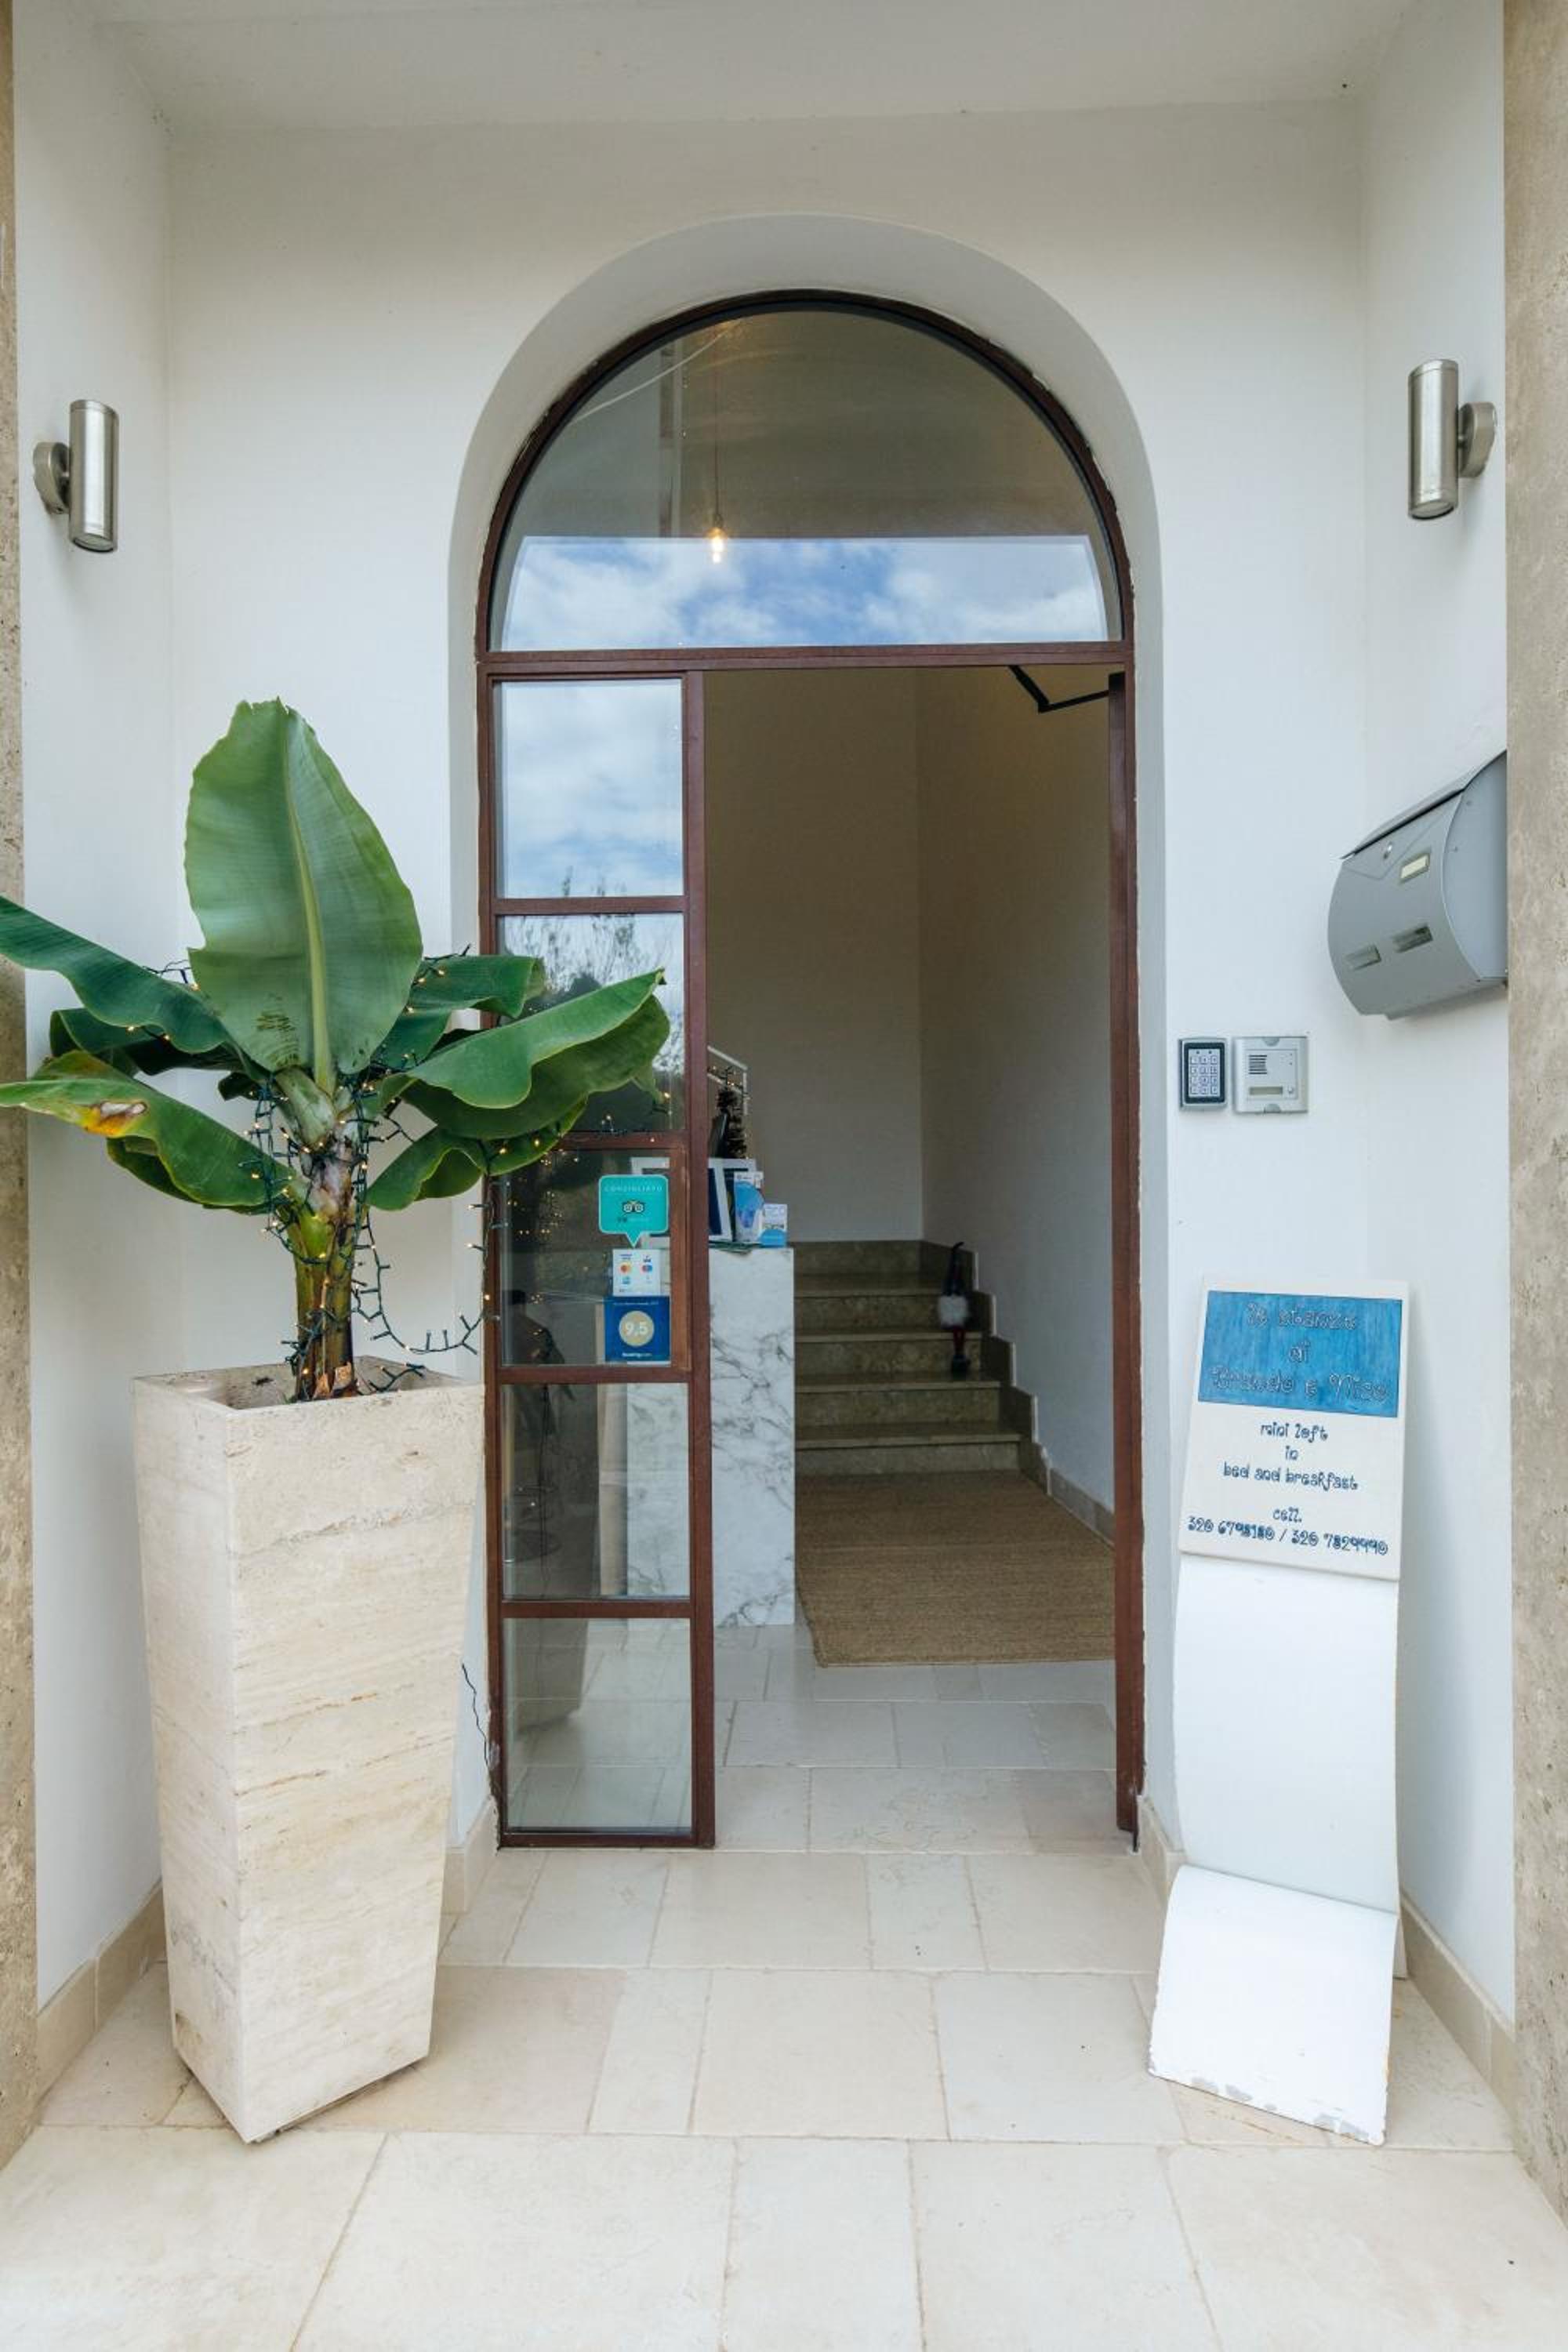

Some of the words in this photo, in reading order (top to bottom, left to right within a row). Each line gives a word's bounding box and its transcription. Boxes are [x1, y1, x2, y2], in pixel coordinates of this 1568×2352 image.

[1261, 1422, 1290, 1437] mini
[1294, 1423, 1328, 1443] loft
[1285, 1445, 1298, 1460] in
[1224, 1461, 1250, 1479] bed
[1254, 1468, 1281, 1483] and
[1286, 1468, 1359, 1490] breakfast
[1188, 1515, 1214, 1533] 320
